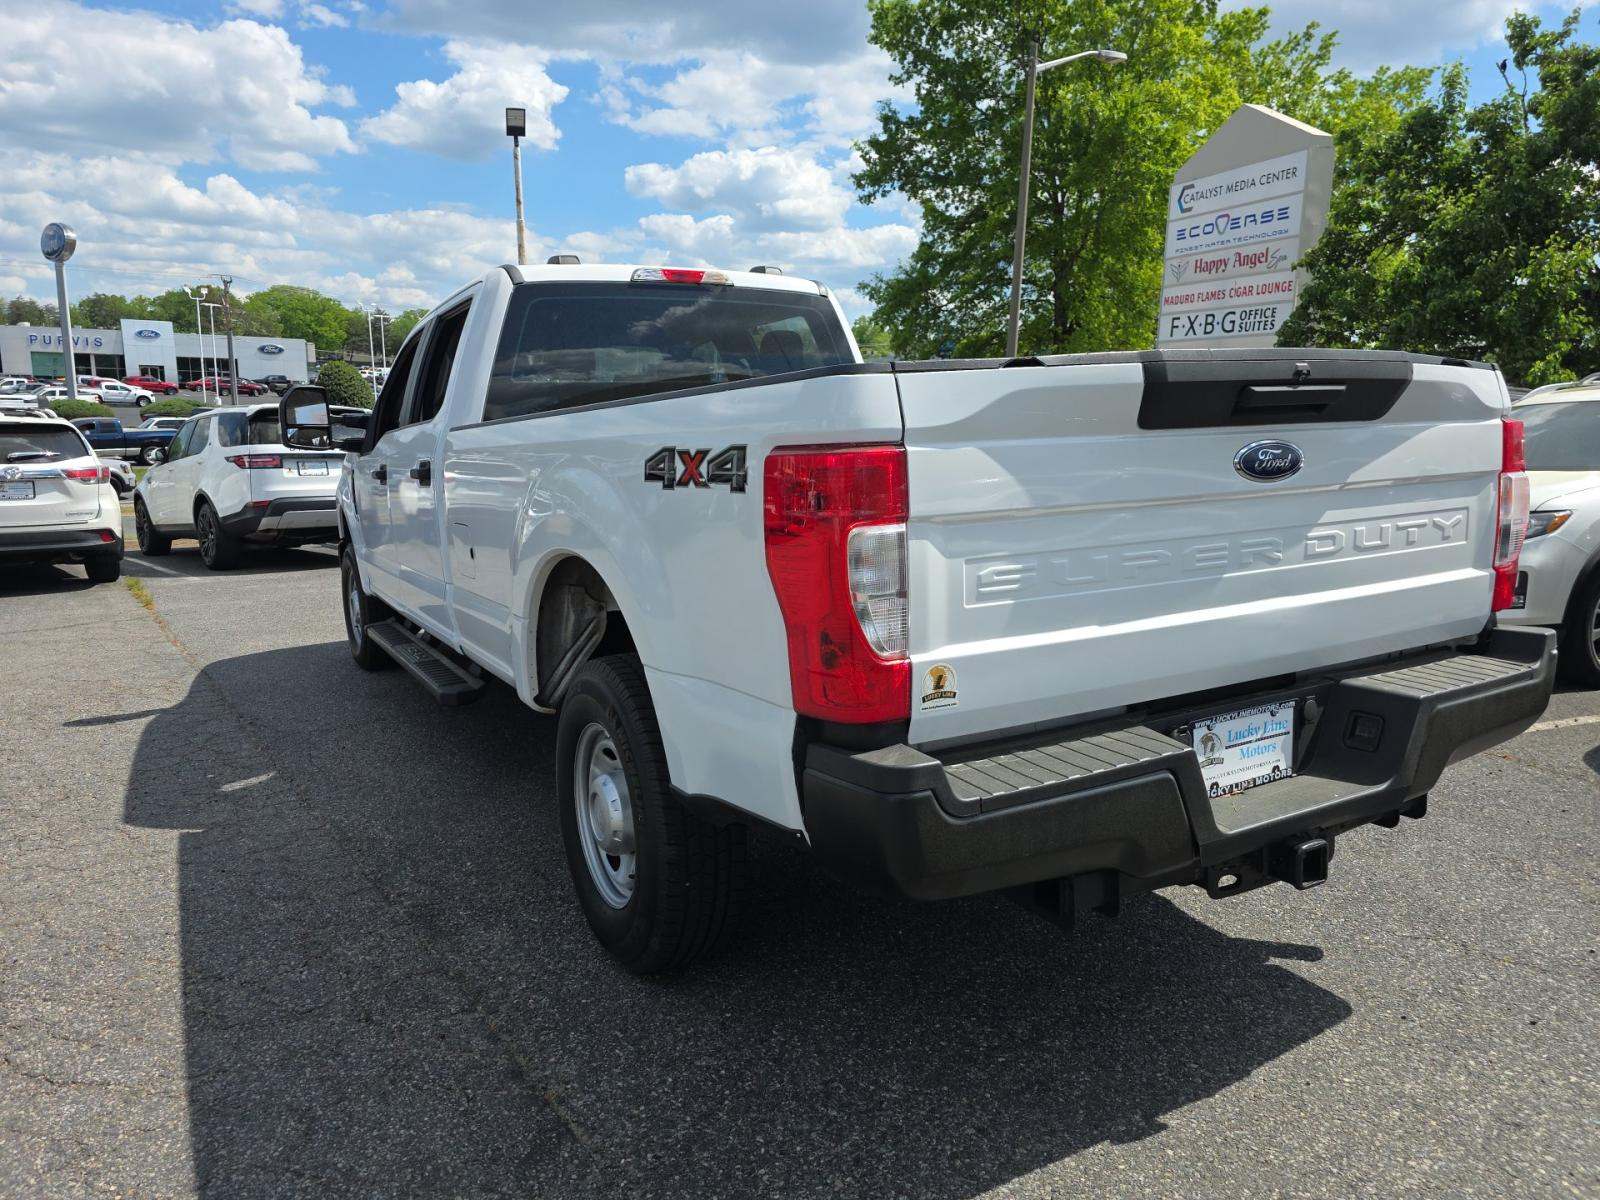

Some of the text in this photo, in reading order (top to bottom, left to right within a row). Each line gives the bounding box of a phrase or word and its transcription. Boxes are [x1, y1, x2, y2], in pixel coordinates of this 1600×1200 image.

[1183, 167, 1298, 205] CATALYST MEDIA CENTER
[1233, 228, 1289, 243] TECHNOLOGY
[1194, 257, 1230, 275] Happy
[1233, 247, 1269, 268] Angel
[1163, 280, 1293, 306] MADURO FLAMES CIGAR LOUNGE
[1239, 307, 1277, 320] OFFICE
[1238, 319, 1275, 332] SUITES
[1255, 448, 1292, 472] Ford
[976, 514, 1464, 594] SUPER DUTY
[1227, 719, 1288, 742] Lucky Line
[1239, 743, 1277, 760] Motors
[1256, 768, 1292, 785] MOTORS
